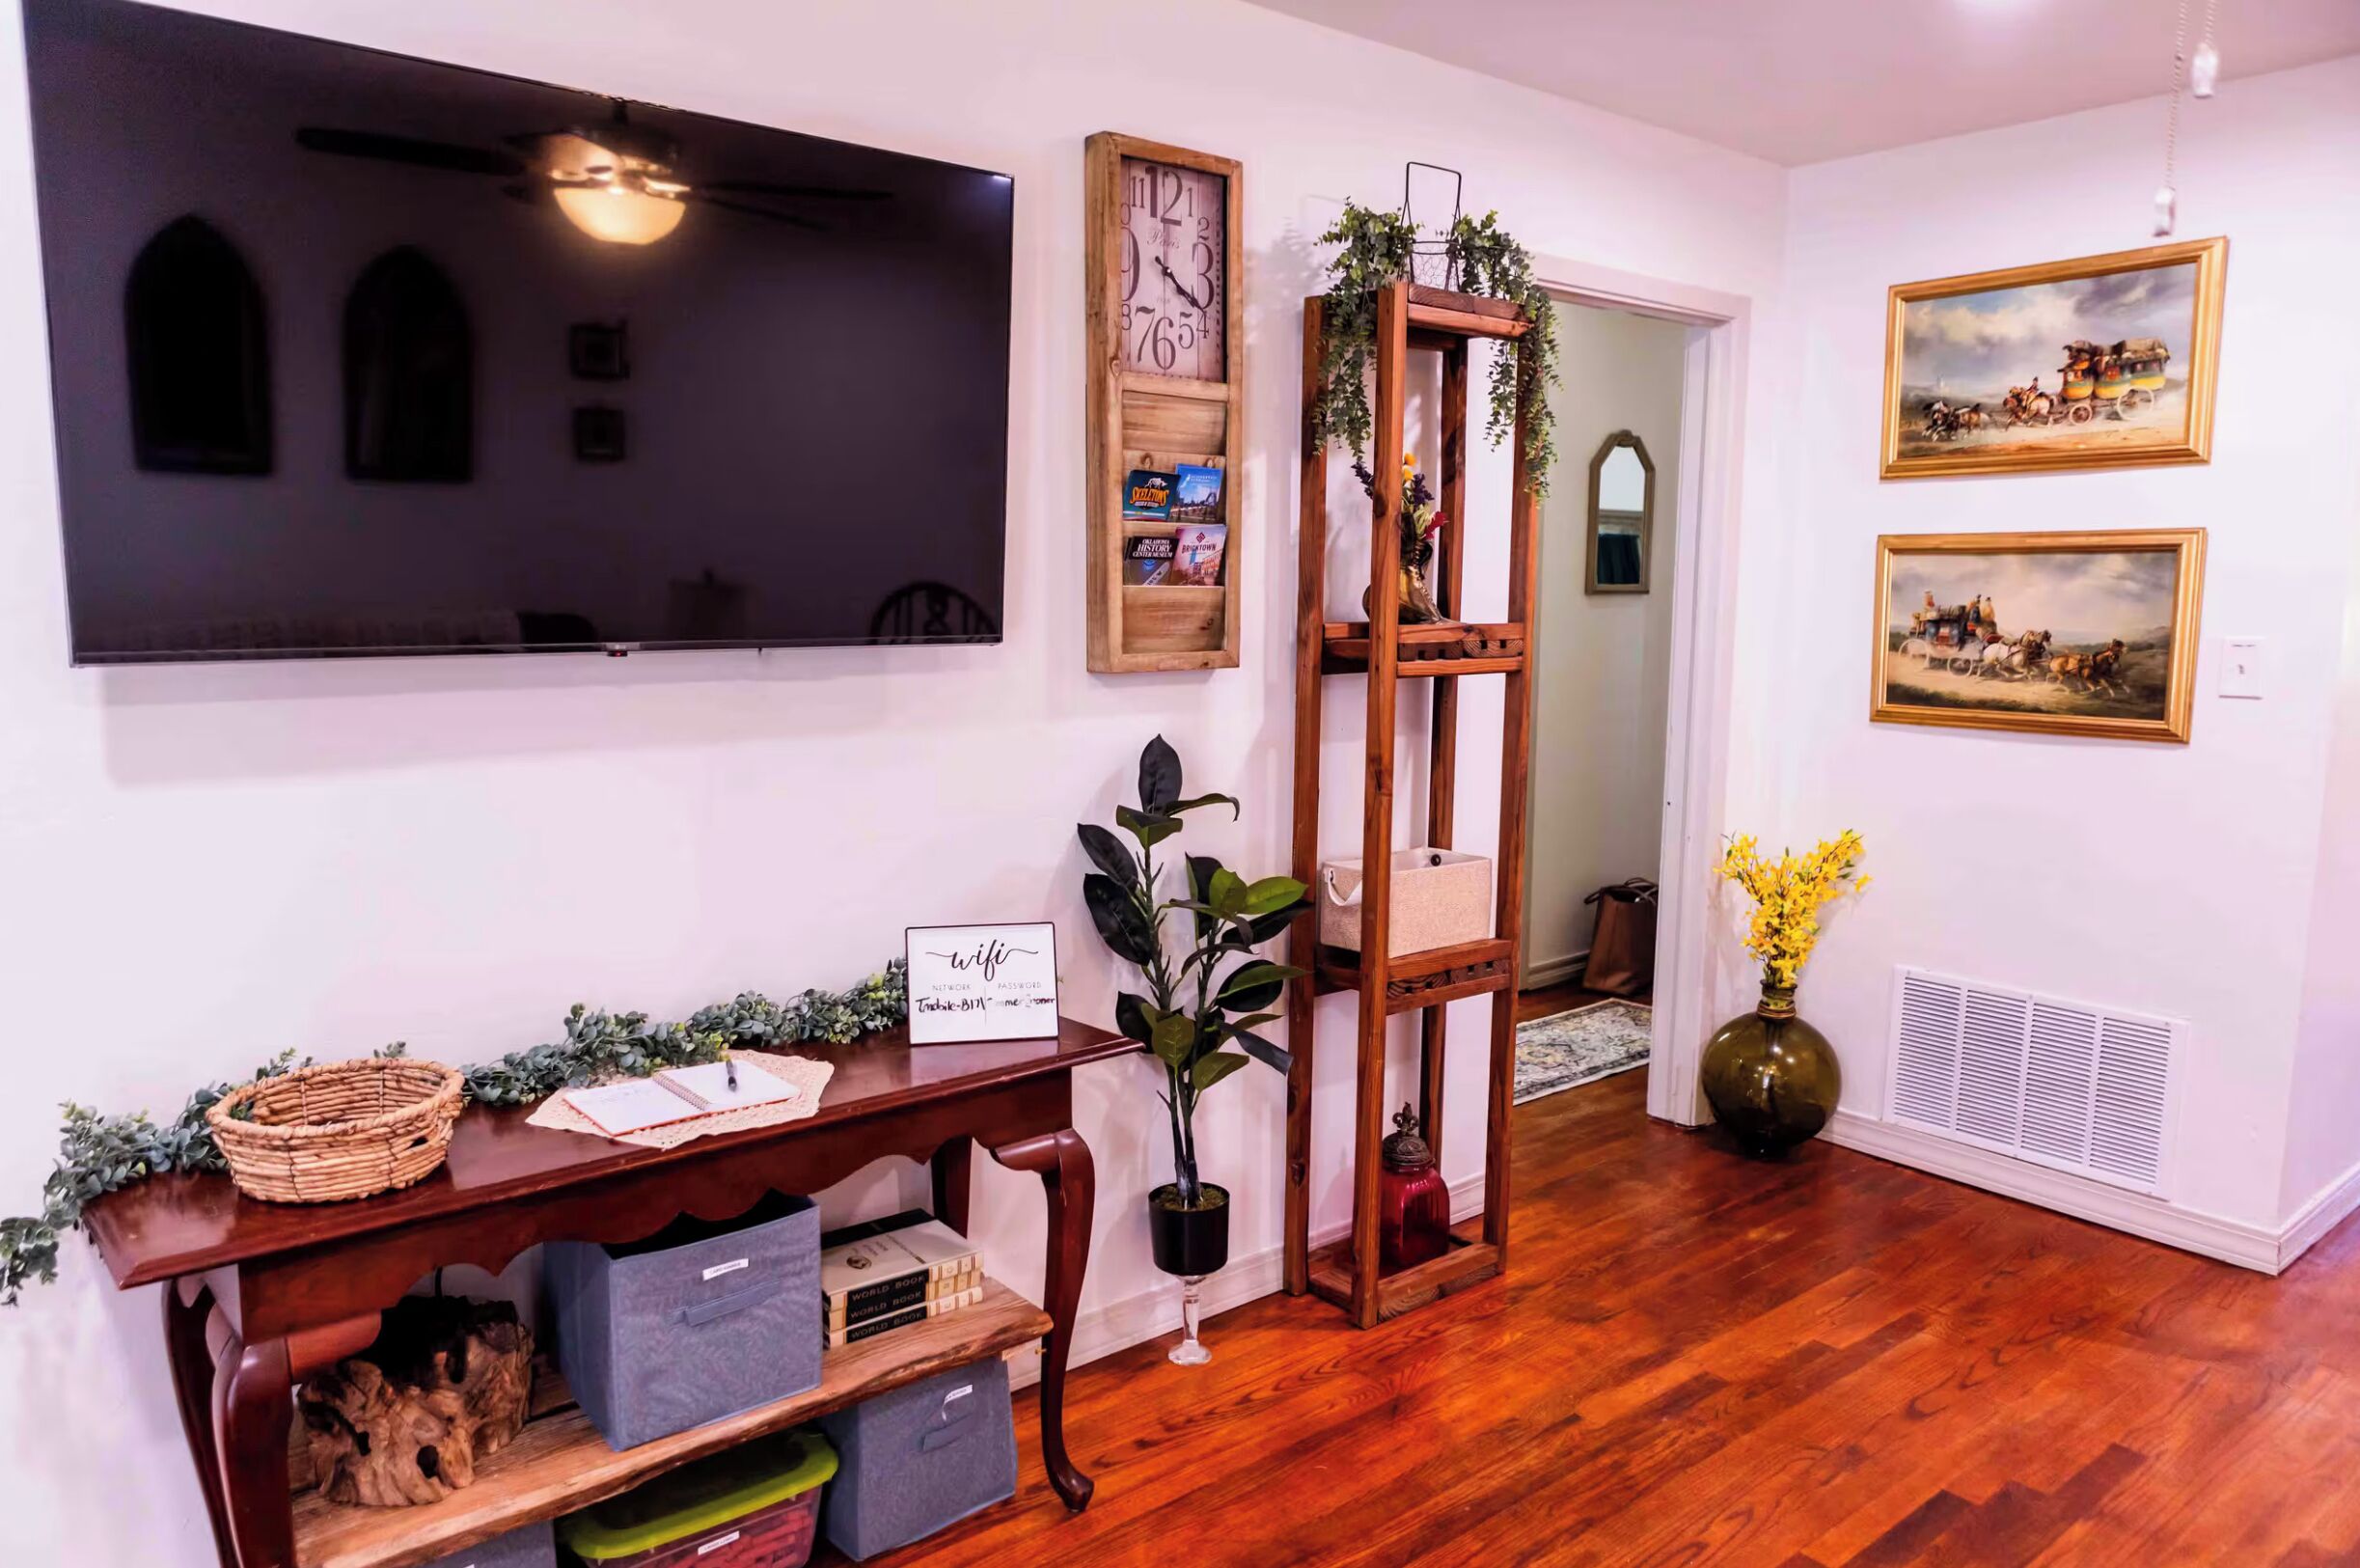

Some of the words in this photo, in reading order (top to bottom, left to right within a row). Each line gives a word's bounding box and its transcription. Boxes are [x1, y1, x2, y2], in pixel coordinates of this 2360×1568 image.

[1131, 176, 1145, 208] 11
[1145, 165, 1183, 226] 12
[1187, 187, 1194, 217] 1
[1147, 228, 1180, 249] Paris
[1197, 216, 1210, 241] 2
[1192, 242, 1215, 310] 3
[1120, 304, 1132, 331] 8
[1178, 312, 1194, 349] 5
[1196, 311, 1209, 339] 4
[1135, 306, 1156, 363] 7
[1153, 316, 1176, 371] 6
[1130, 487, 1169, 507] SKELETONS
[1182, 543, 1217, 554] BRICKTOWN
[932, 983, 972, 992] NETWORK
[998, 981, 1041, 990] PASSWORD
[851, 1285, 890, 1301] WORLD
[895, 1276, 924, 1289] BOOK
[850, 1302, 887, 1318] WORLD
[892, 1291, 921, 1305] BOOK
[851, 1322, 888, 1338] WORLD
[893, 1311, 922, 1326] BOOK
